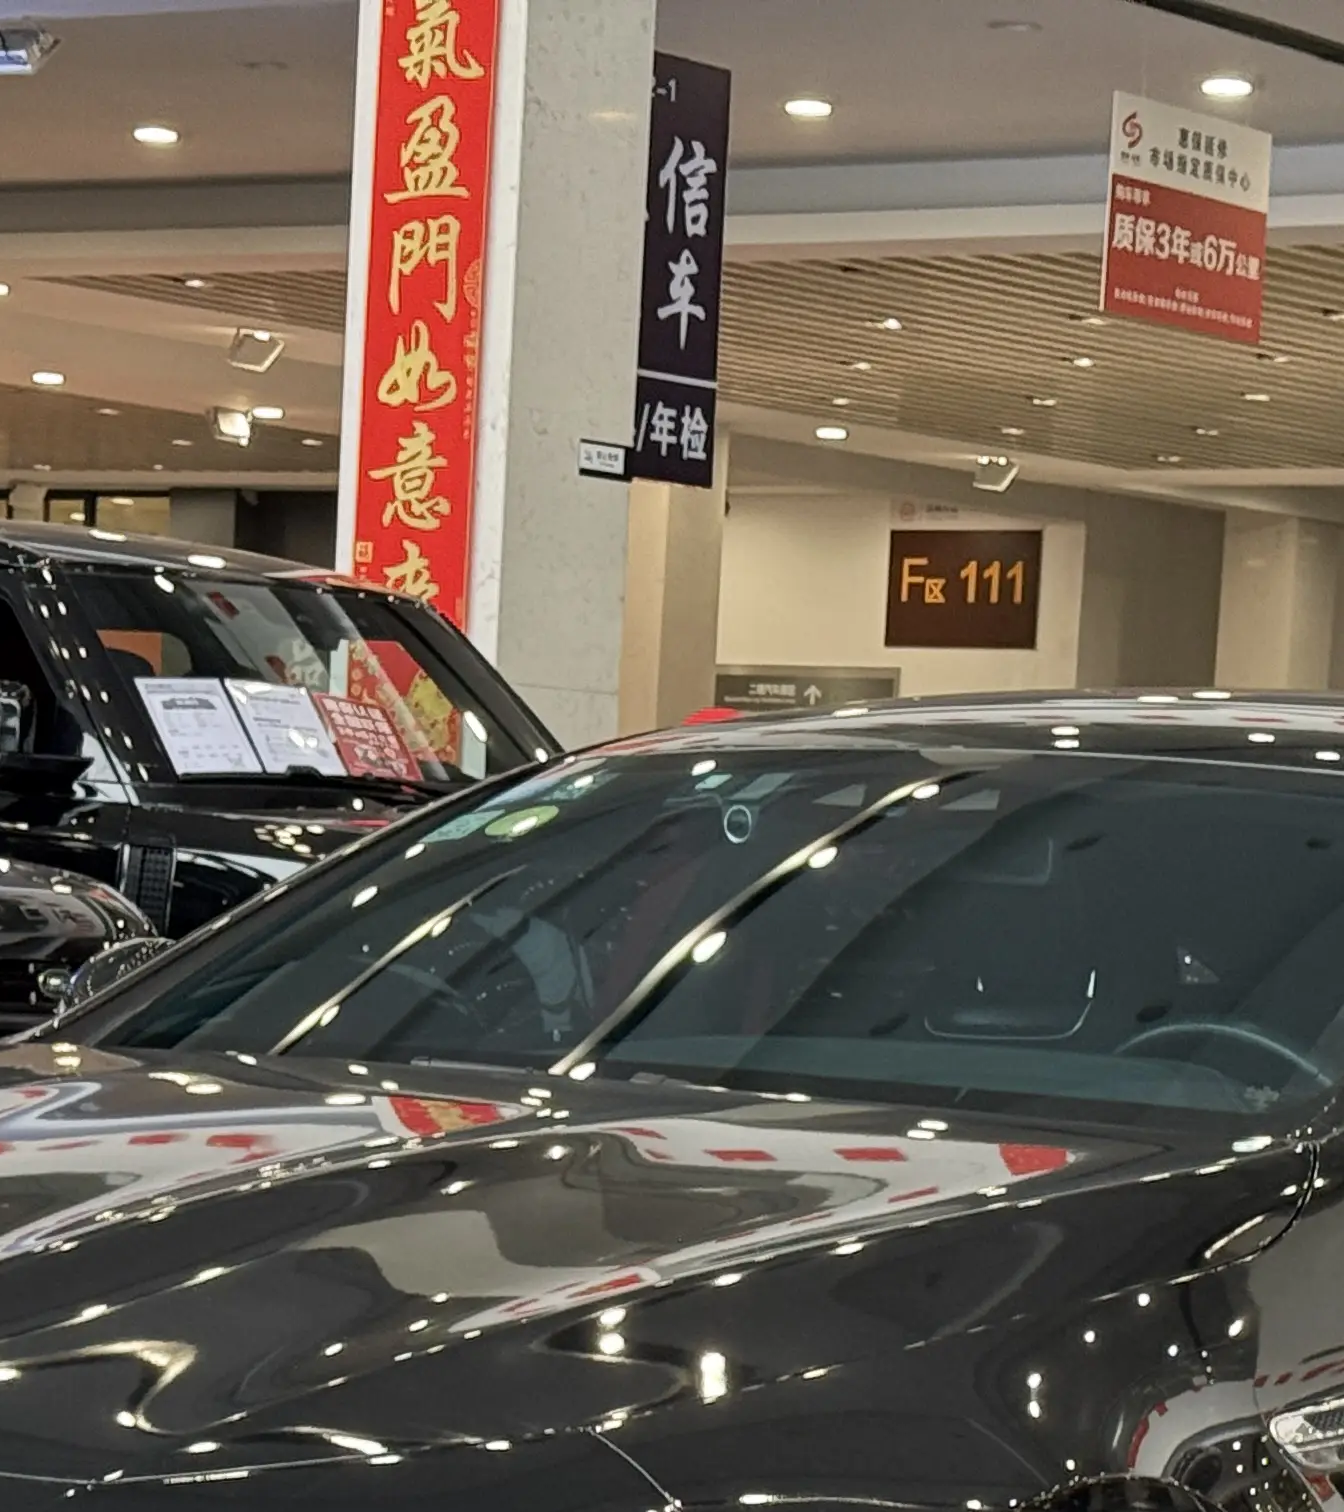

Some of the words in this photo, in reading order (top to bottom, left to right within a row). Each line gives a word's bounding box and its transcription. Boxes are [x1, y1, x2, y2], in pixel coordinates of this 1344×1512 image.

[651, 76, 677, 102] -1
[1112, 212, 1261, 280] 质保3年或6万公里
[960, 559, 1025, 605] 111
